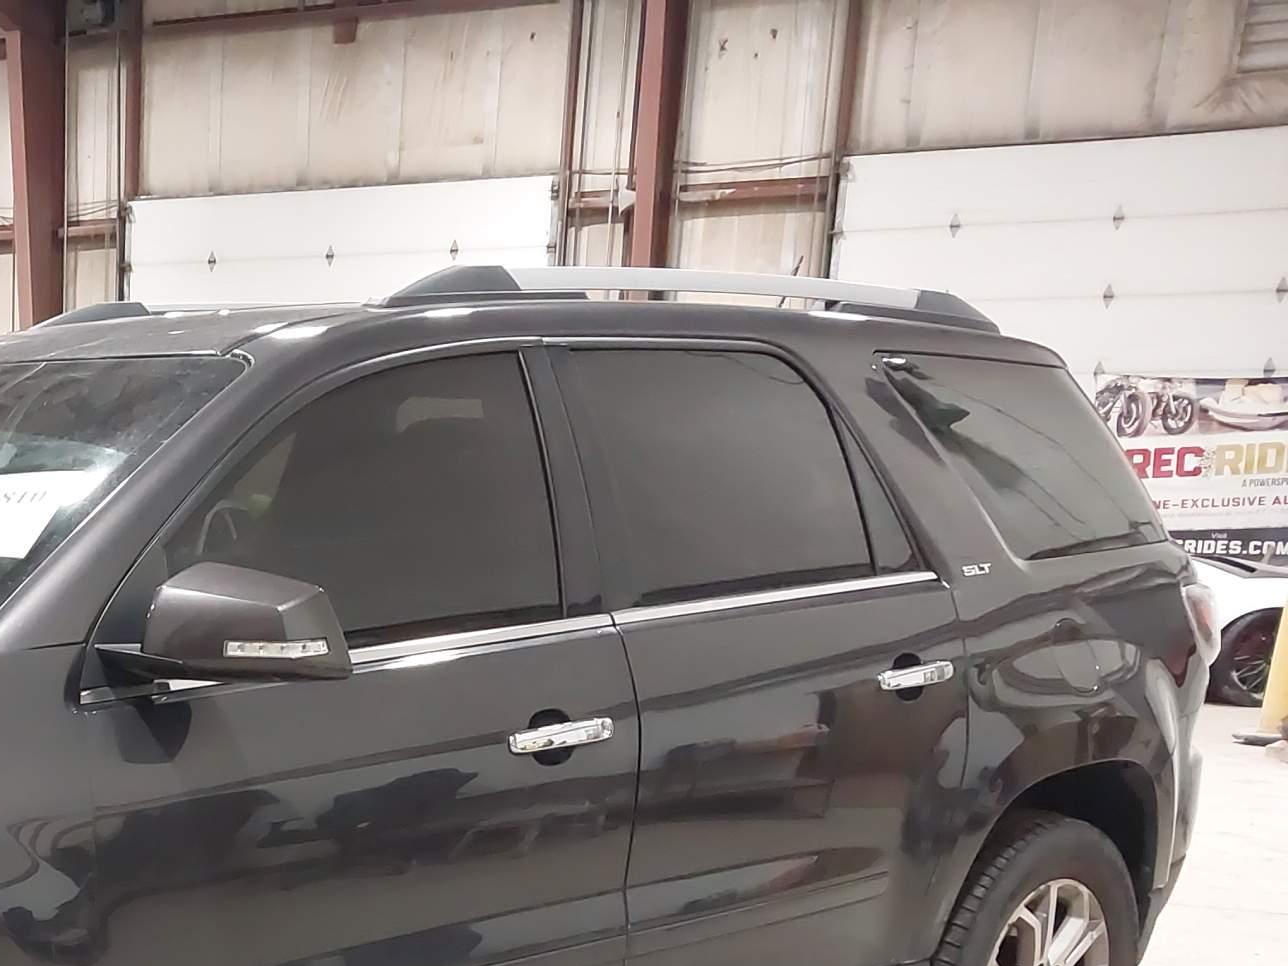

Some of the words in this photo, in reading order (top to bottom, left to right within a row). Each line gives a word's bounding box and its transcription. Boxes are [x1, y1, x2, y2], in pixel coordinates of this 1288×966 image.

[1124, 446, 1206, 479] REC
[1214, 441, 1288, 476] RID
[1211, 531, 1228, 539] Visit
[1176, 538, 1288, 555] RIDES.COM
[962, 562, 992, 577] SLT
